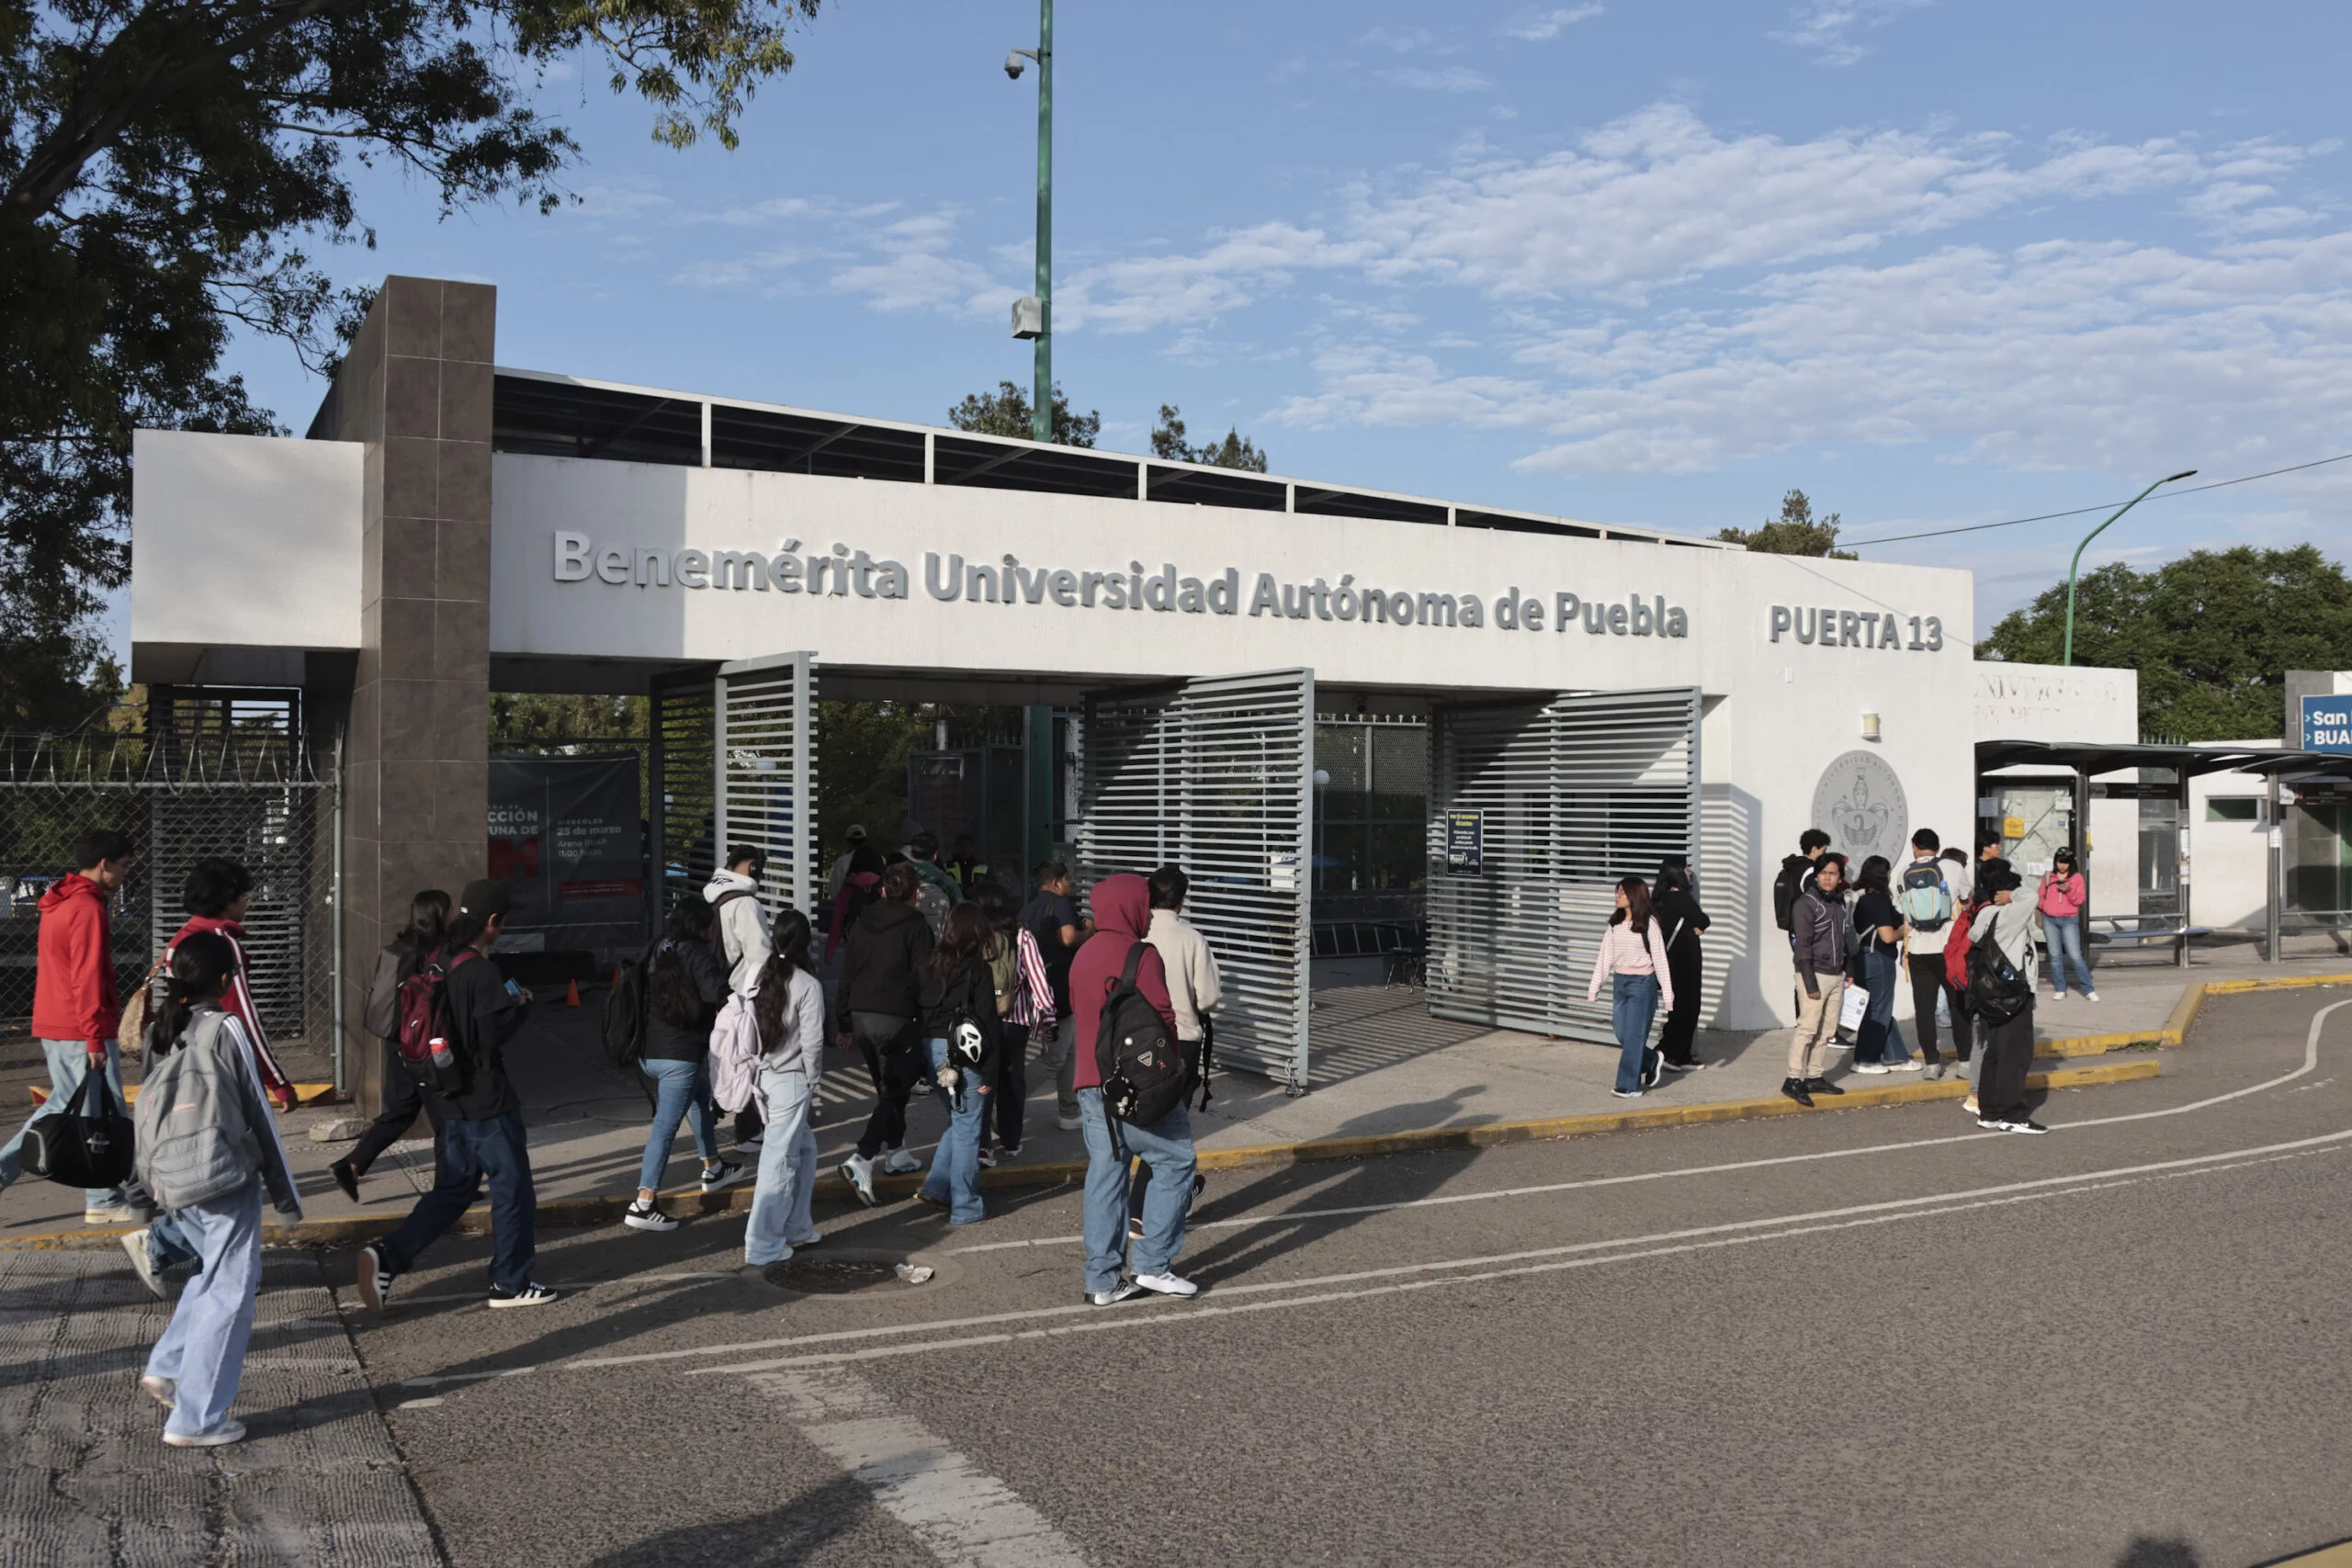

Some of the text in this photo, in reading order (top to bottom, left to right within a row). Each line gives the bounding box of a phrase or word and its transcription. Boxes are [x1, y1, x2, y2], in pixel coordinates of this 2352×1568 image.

[553, 531, 1688, 638] Benemérita Universidad Autónoma de Puebla
[1770, 605, 1943, 652] PUERTA 13
[2312, 711, 2347, 726] San
[2314, 729, 2352, 745] BUA
[488, 826, 538, 836] UNA DE
[557, 827, 622, 836] 25 de marzo
